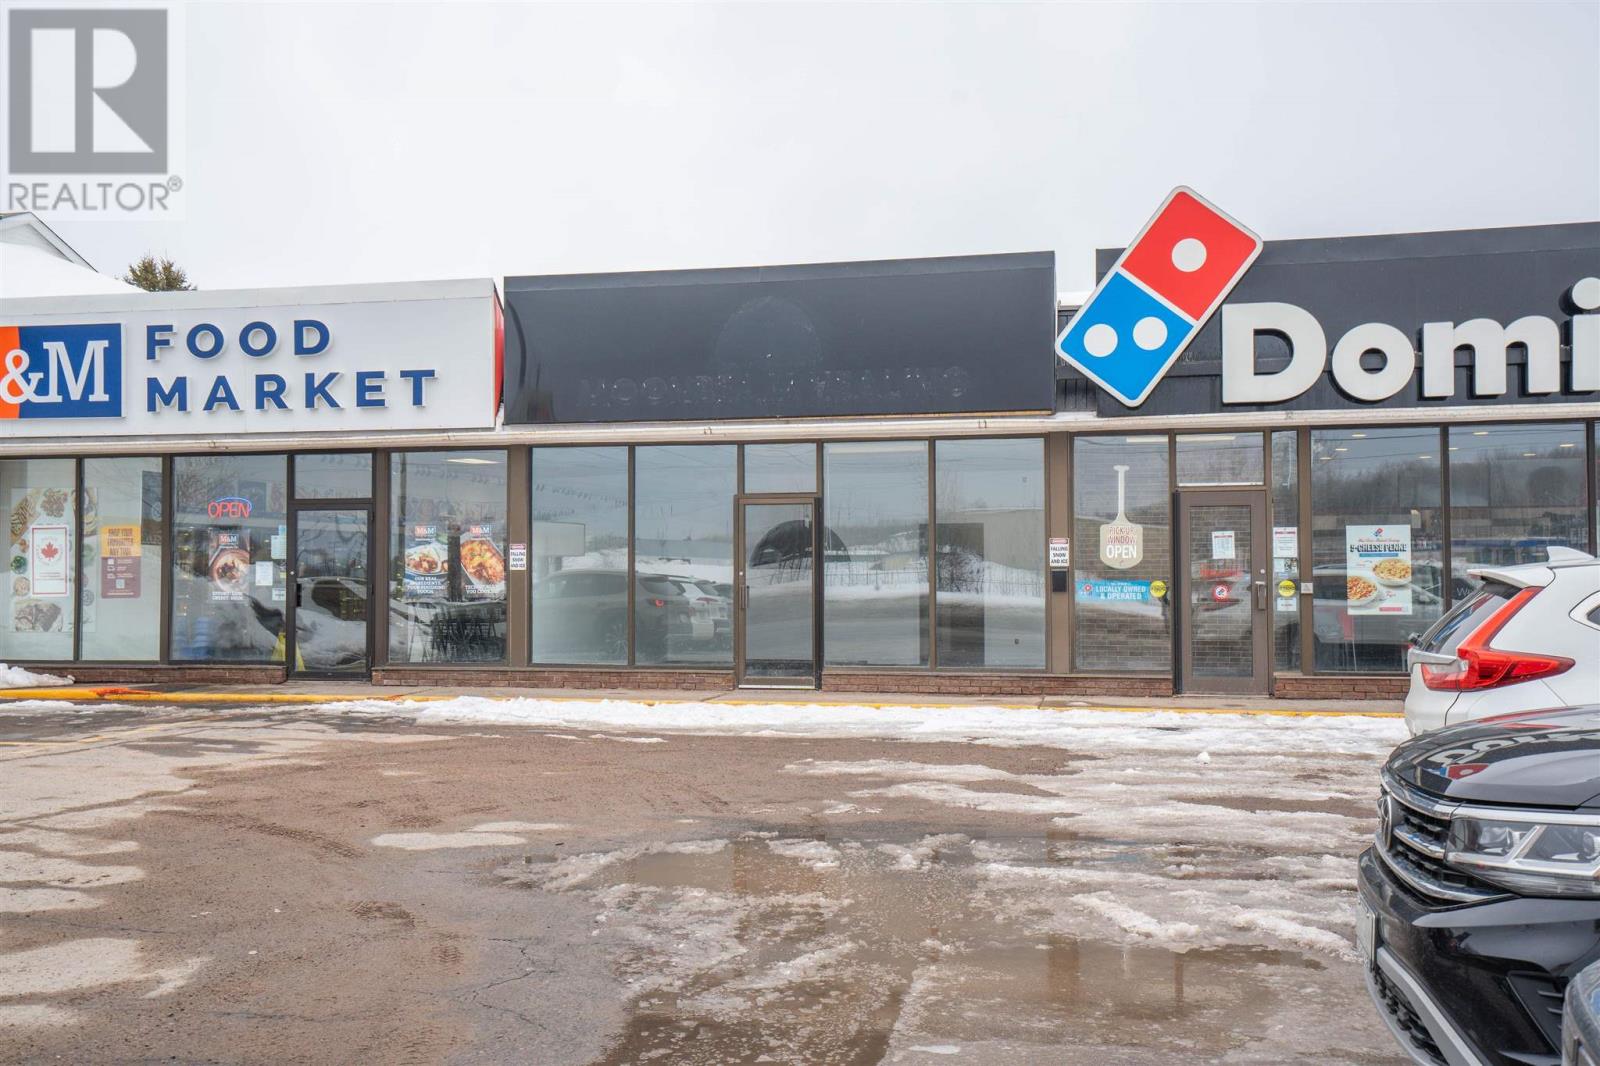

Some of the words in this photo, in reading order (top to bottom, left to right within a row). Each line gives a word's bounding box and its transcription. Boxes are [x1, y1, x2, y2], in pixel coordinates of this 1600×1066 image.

[146, 319, 332, 361] FOOD
[1222, 277, 1600, 404] Domi
[146, 369, 438, 413] MARKET
[208, 501, 250, 518] OPEN
[1106, 545, 1137, 559] OPEN
[1095, 585, 1122, 593] LOCALLY
[1107, 592, 1142, 600] OPERATED
